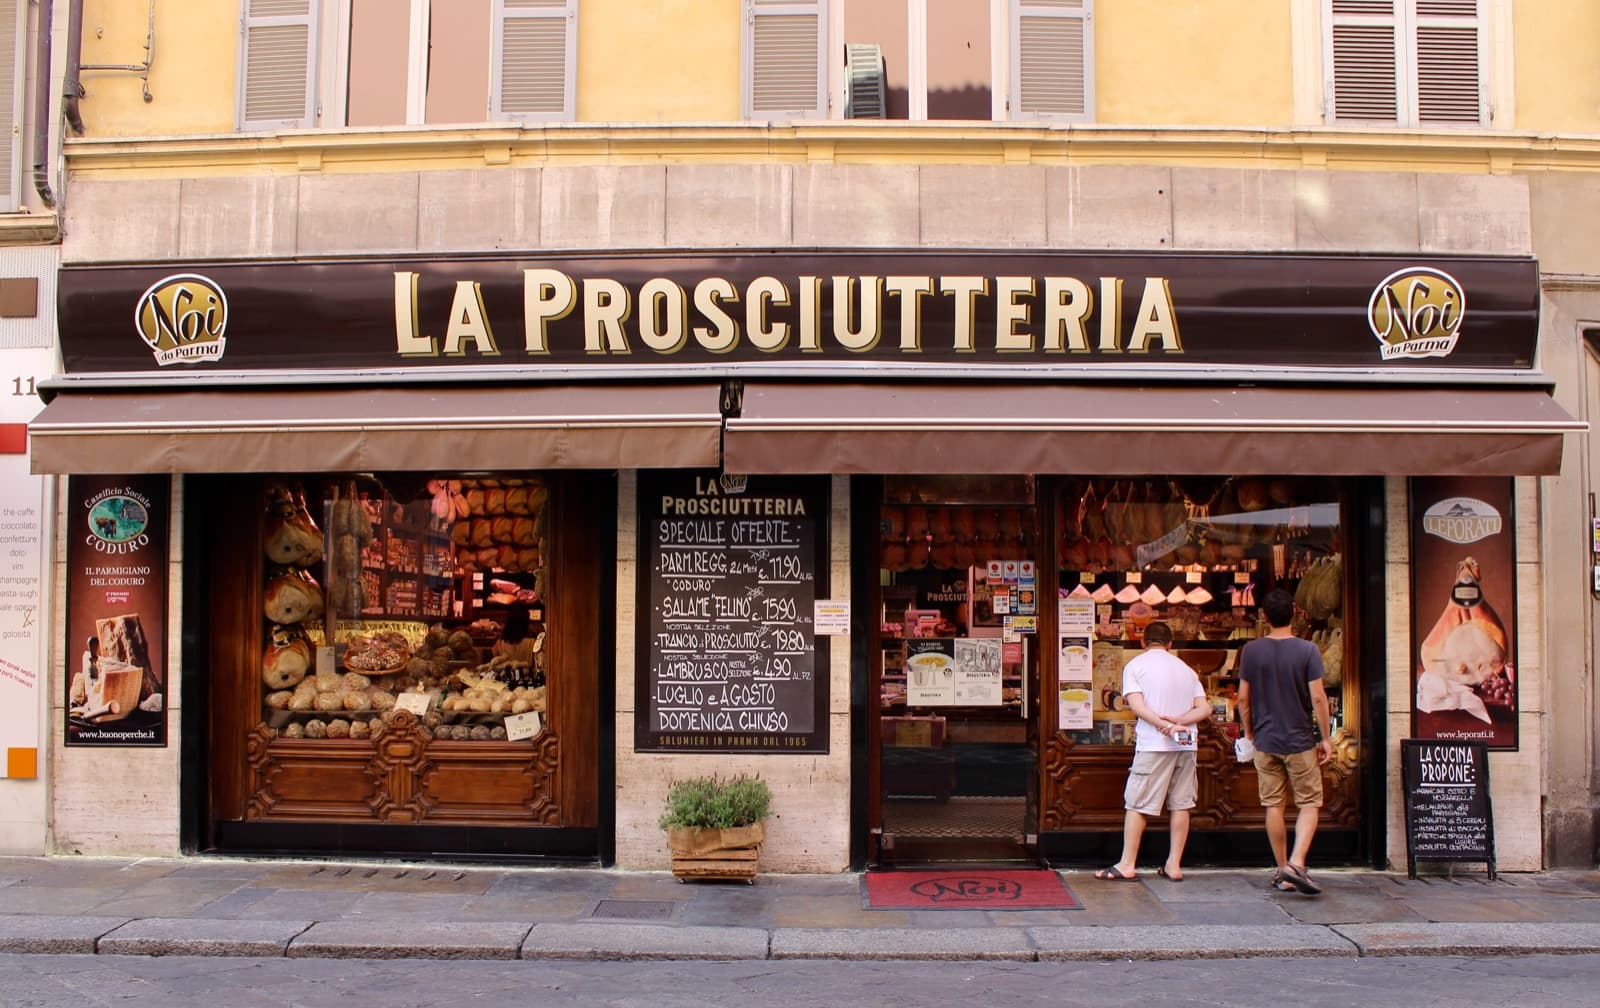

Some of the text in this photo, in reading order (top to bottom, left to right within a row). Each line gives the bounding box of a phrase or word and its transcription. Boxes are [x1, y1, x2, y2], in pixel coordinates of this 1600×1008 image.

[148, 286, 223, 346] Noi
[394, 268, 1184, 357] LA PROSCIUTTERIA
[1380, 279, 1460, 340] Noi
[160, 343, 219, 361] da Parma
[1386, 339, 1450, 355] da Parma
[12, 376, 38, 396] 11
[696, 476, 719, 496] LA
[124, 486, 152, 508] Sociale
[662, 496, 806, 515] PROSCIUTTERIA
[659, 520, 726, 543] SPECIALE
[1428, 518, 1498, 541] LEPORATI
[86, 533, 149, 555] CODURO
[85, 566, 150, 576] IL PARMIGIANO
[90, 577, 145, 586] DEL CODURO
[662, 595, 711, 618] SALAME
[666, 623, 731, 631] NOSTRA SELEZIONE
[657, 632, 698, 649] TRANCIO
[704, 631, 759, 649] PROSCIUTTO
[658, 661, 728, 680] LAMBRUSCO
[657, 683, 775, 706] LUGLIO e AGOSTO
[659, 711, 788, 731] DOMENICA CHIUSO
[79, 730, 155, 740] www.buonoperche.it
[660, 736, 709, 747] SALUMIERI
[714, 736, 723, 746] IN
[728, 737, 758, 746] PARMA
[1436, 730, 1494, 740] www.leporati.it
[1420, 747, 1473, 764] LA CUCINA
[1421, 764, 1476, 782] PROPONE:
[933, 880, 1008, 900] Noi
